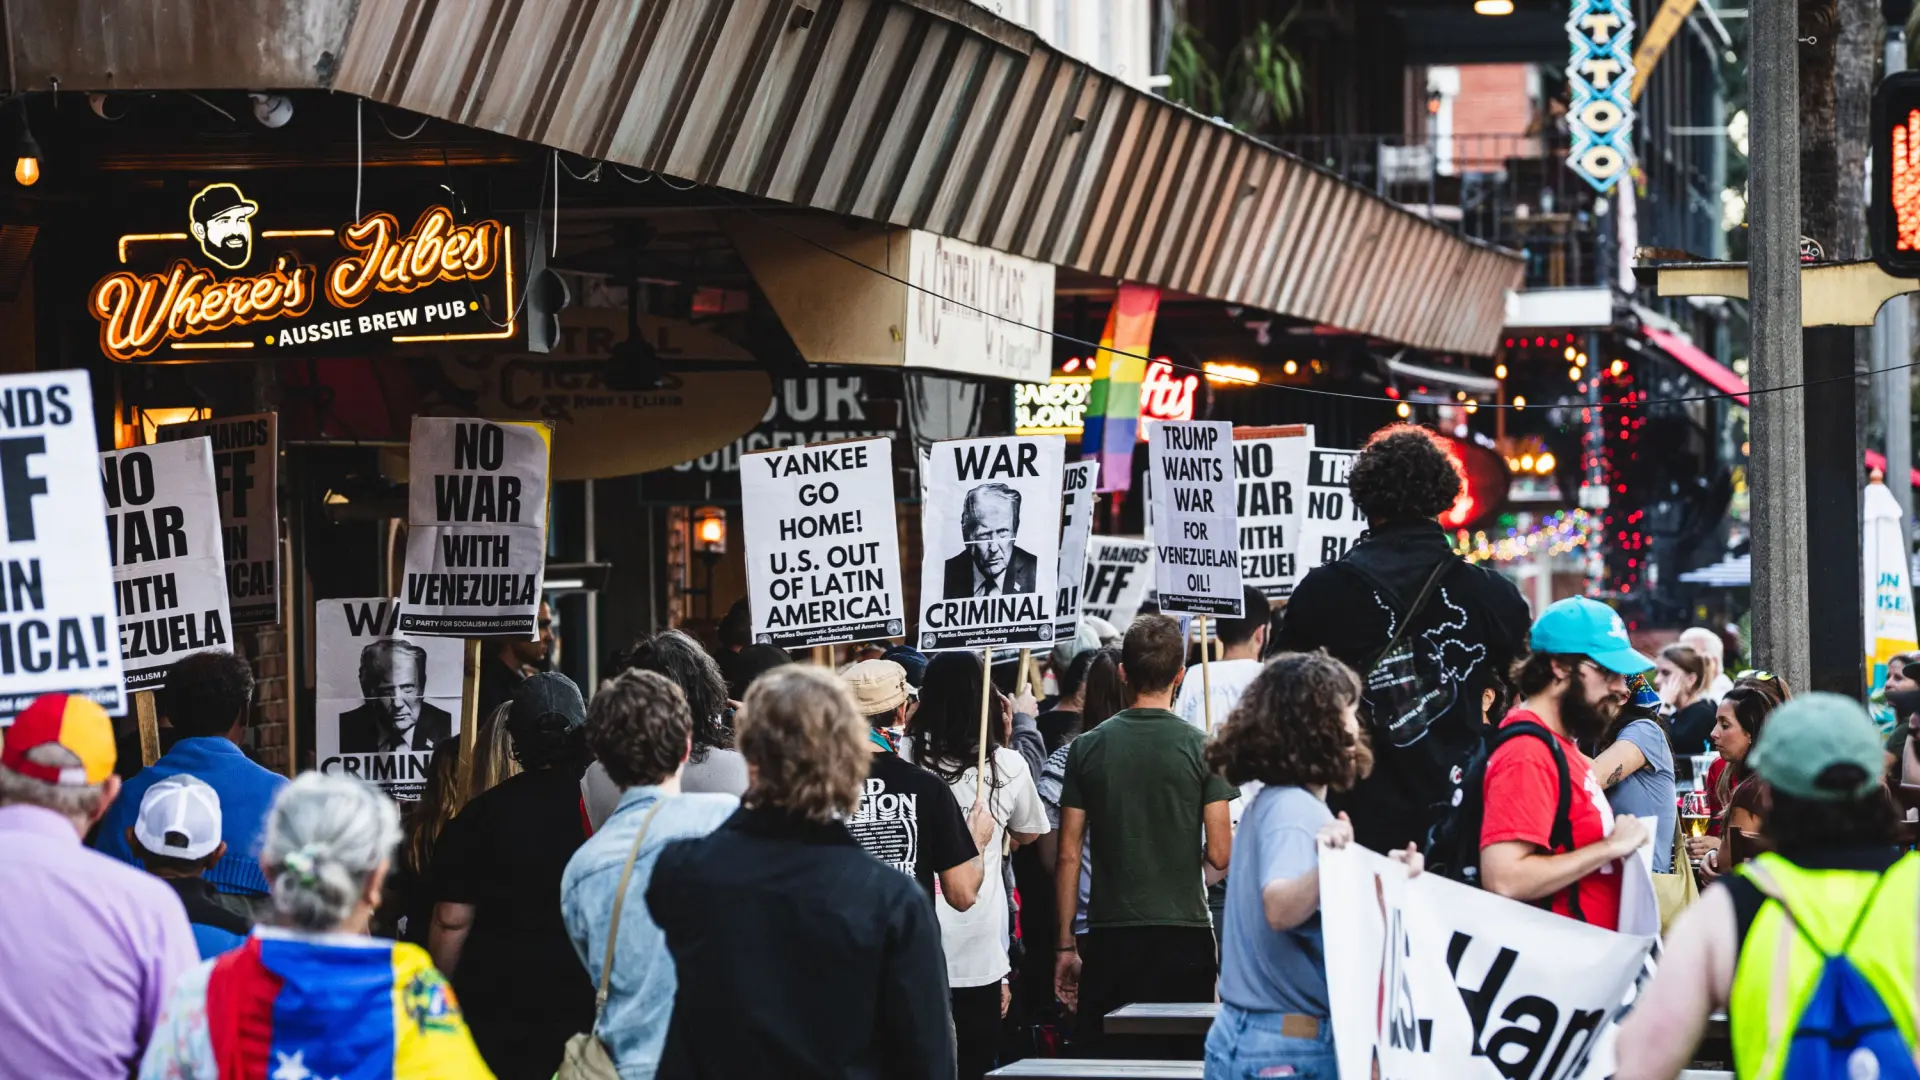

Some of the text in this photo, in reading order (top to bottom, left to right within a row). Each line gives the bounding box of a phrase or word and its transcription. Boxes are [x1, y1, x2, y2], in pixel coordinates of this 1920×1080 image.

[91, 206, 498, 357] Where's Jubes
[278, 299, 468, 347] AUSSIE BREW PUB
[454, 423, 504, 470] NO
[1162, 425, 1219, 451] TRUMP
[764, 445, 868, 479] YANKEE
[954, 442, 1040, 482] WAR
[1162, 456, 1223, 483] WANTS
[1234, 442, 1274, 479] NO
[100, 451, 156, 509] NO
[799, 481, 839, 507] GO
[434, 475, 521, 522] WAR
[1173, 487, 1215, 513] WAR
[1307, 491, 1344, 521] NO
[779, 509, 863, 541] HOME!
[1183, 521, 1209, 541] FOR
[443, 535, 510, 567] WITH
[769, 541, 880, 575] U.S. OUT
[1099, 546, 1149, 564] HANDS
[1158, 546, 1238, 569] VENEZUELAN
[408, 573, 536, 607] VENEZUELA
[769, 567, 885, 601] OF LATIN
[1187, 573, 1211, 593] OIL!
[416, 619, 440, 627] PARTY
[453, 620, 488, 628] SOCIALISM
[500, 619, 533, 627] LIBERATION
[766, 592, 892, 628] AMERICA!
[925, 594, 1050, 628] CRIMINAL
[773, 631, 796, 640] Pinellas
[796, 628, 827, 637] Democratic
[827, 626, 854, 634] Socialists
[861, 622, 885, 630] America
[806, 633, 854, 645] pinellasdsa.org
[937, 625, 1038, 639] Pinellas Democratic Socialists of America
[965, 636, 1008, 646] pinellasdsa.org
